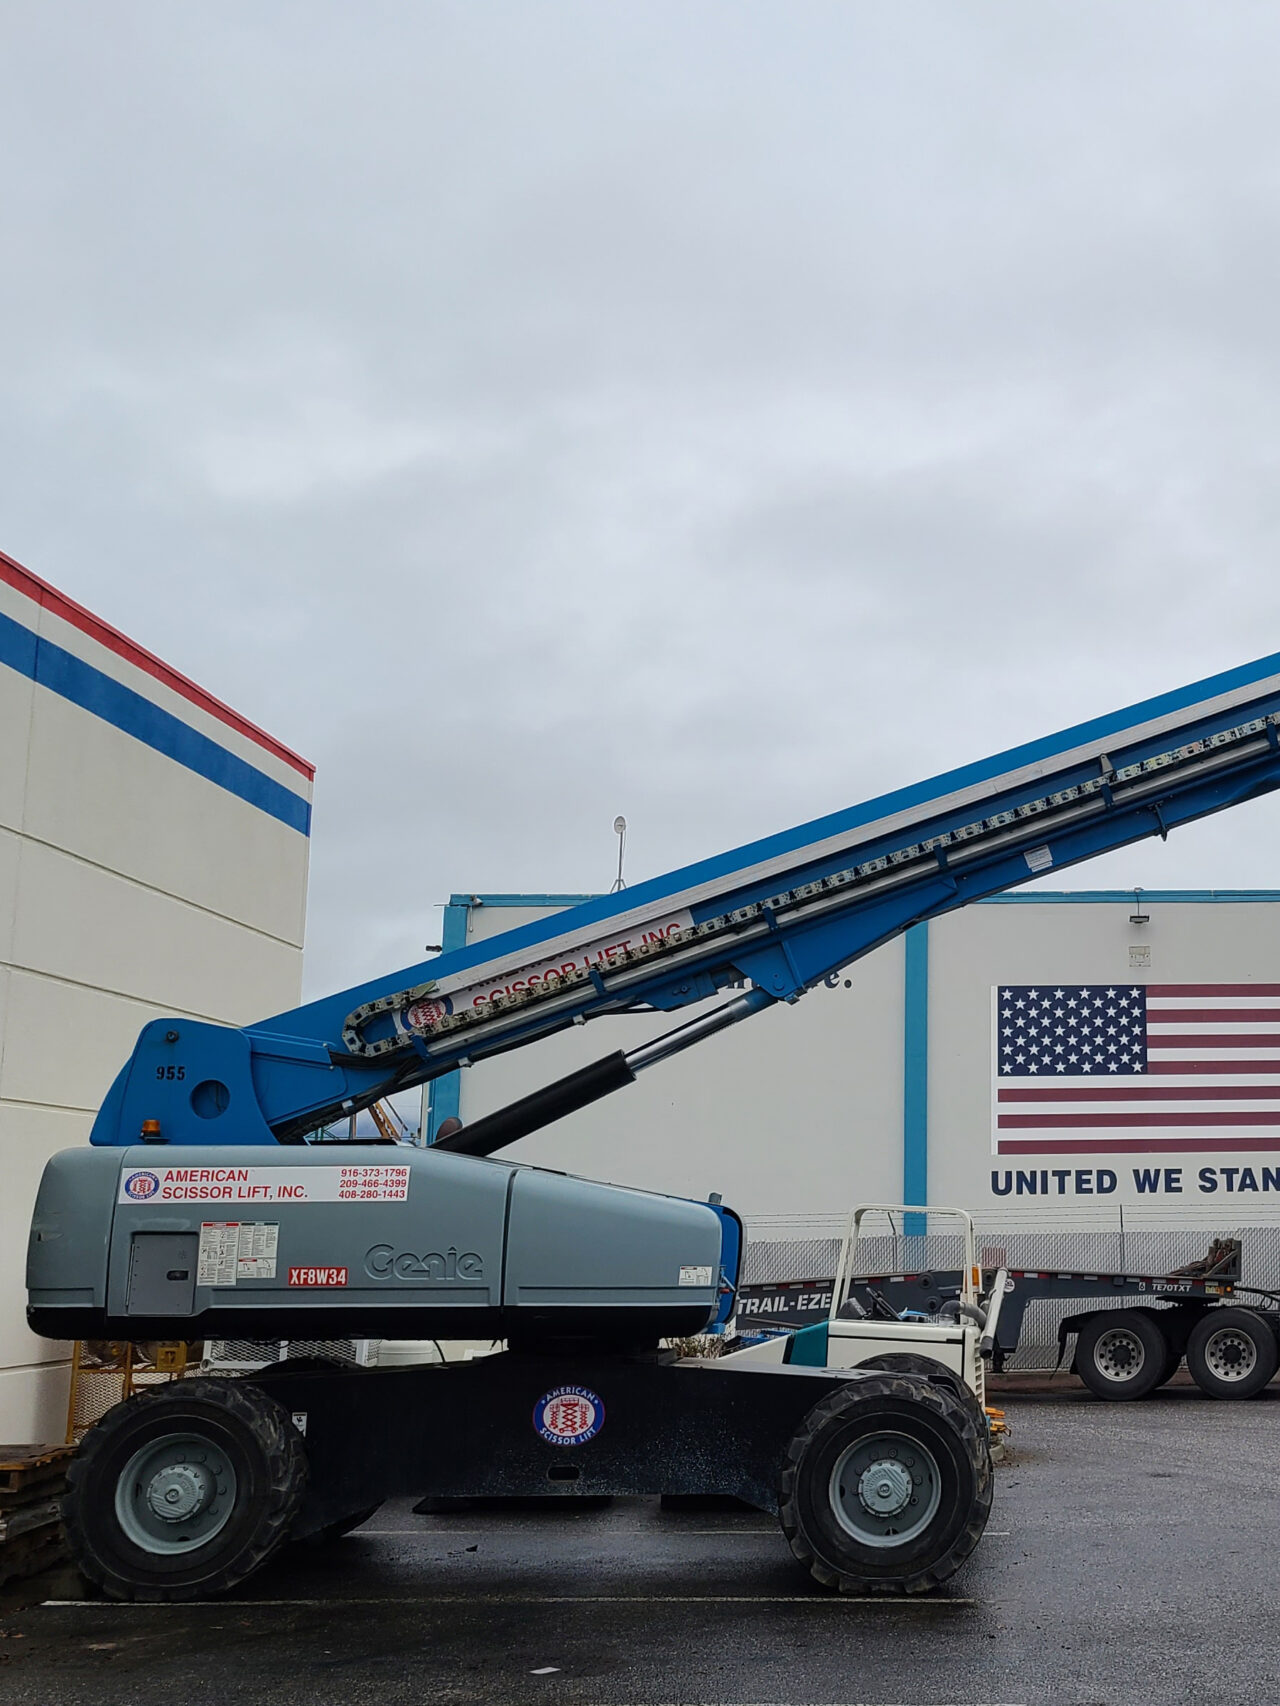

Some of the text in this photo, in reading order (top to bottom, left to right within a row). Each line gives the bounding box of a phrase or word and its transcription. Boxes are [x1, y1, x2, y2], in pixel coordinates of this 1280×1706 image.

[156, 1065, 185, 1080] 955
[163, 1169, 249, 1182] AMERICAN
[341, 1168, 407, 1177] 916-373-1796
[339, 1179, 407, 1188] 209-466-4399
[991, 1169, 1118, 1196] UNITED
[1132, 1168, 1183, 1193] WE
[161, 1185, 309, 1200] SCISSOR LIFT, INC.
[338, 1189, 405, 1199] 408-280-1443
[363, 1243, 484, 1280] Genie
[290, 1268, 346, 1285] XF8W34
[1152, 1283, 1193, 1292] TE70TXT
[737, 1293, 832, 1315] TRAIL-EZE
[546, 1386, 596, 1401] AMERICAN
[540, 1426, 597, 1445] SCISSOR LIFT
